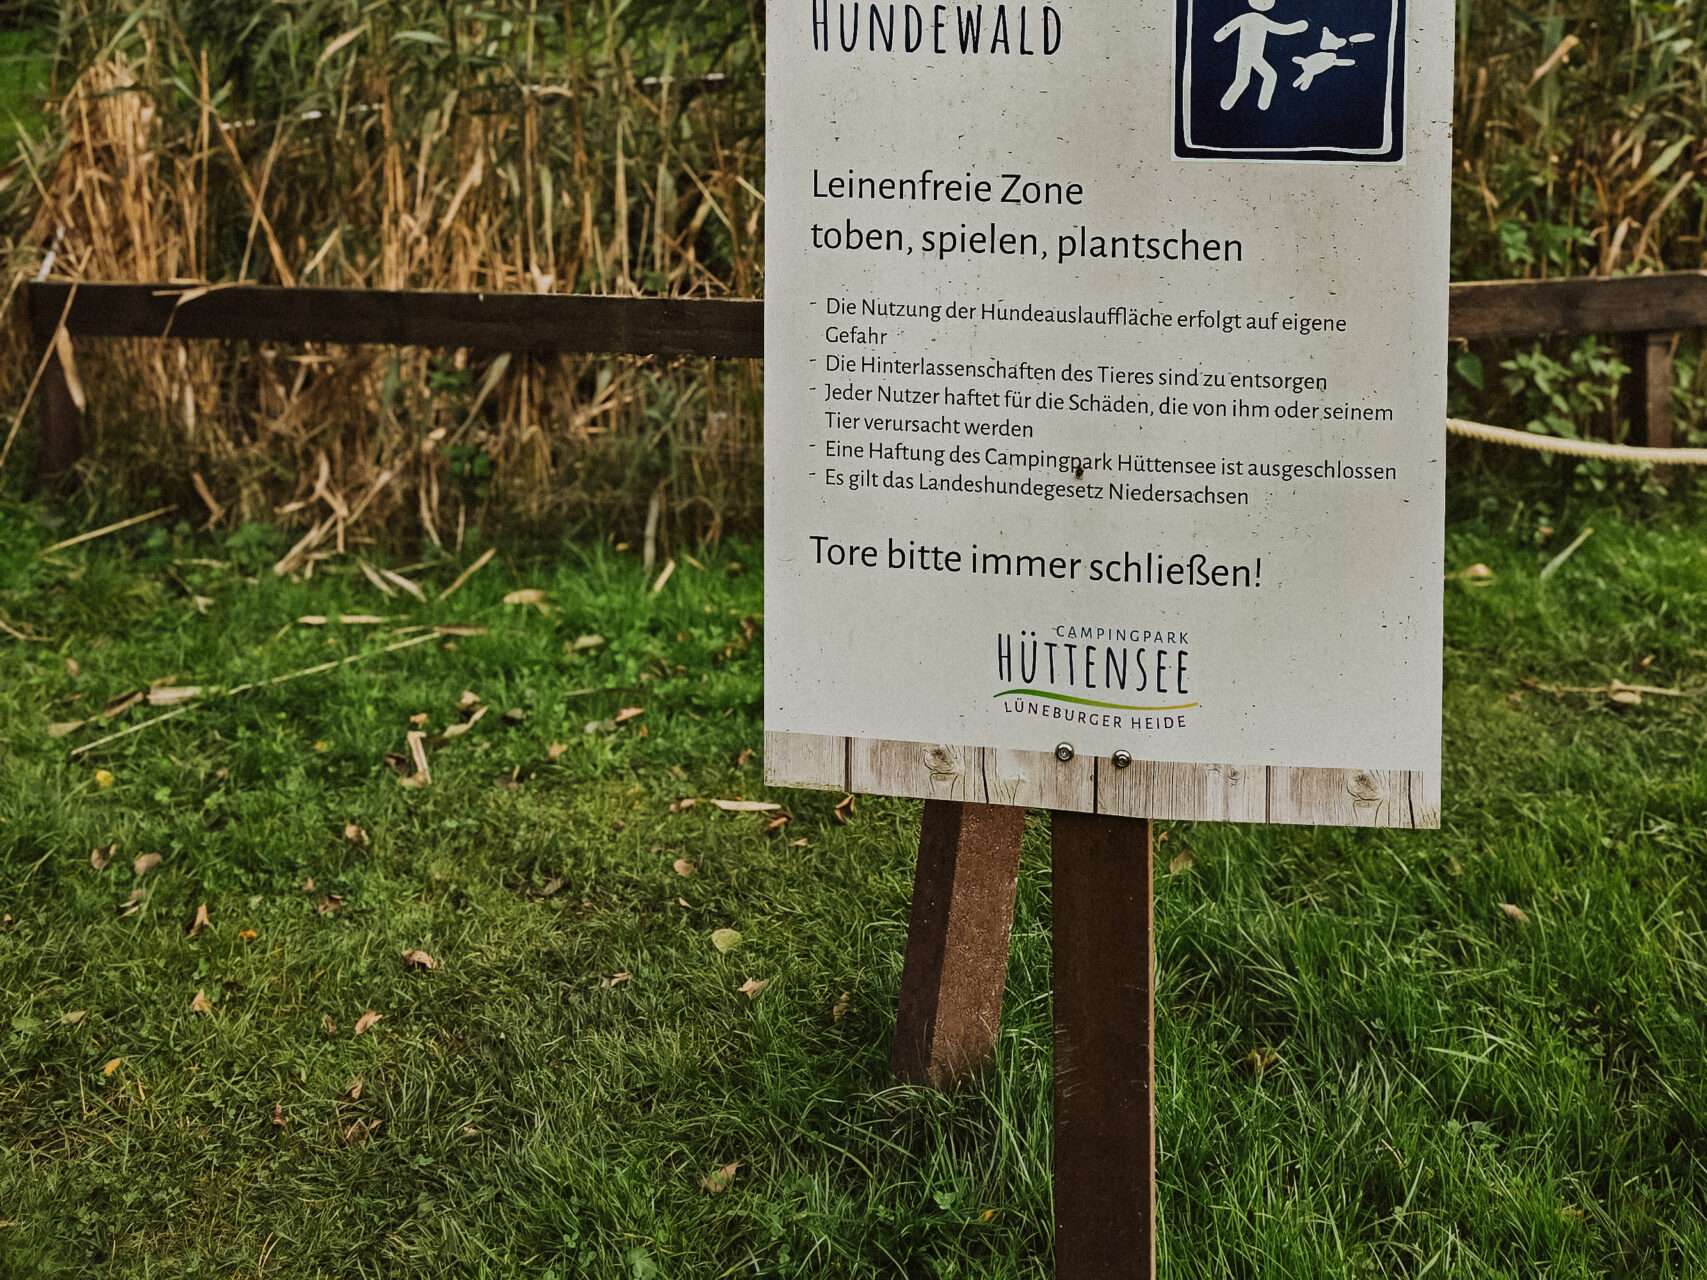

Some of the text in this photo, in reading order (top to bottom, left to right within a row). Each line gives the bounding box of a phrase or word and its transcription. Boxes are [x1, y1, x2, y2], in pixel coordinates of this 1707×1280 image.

[811, 168, 1085, 205] Leinenfreie Zone
[810, 221, 1244, 263] toben, spielen, plantschen
[824, 325, 888, 346] Gefahr
[825, 297, 1347, 336] Die Nutzung der Hundeauslauffläche erfolgt auf eigene
[825, 354, 1328, 394] Die Hinterlassenschaften des Tieres sind zu entsorgen
[823, 382, 1394, 422] Jeder Nutzer haftet für die Schäden, die von ihm oder seinem
[824, 412, 1034, 439] Tier verursacht werden
[824, 440, 1397, 482] Eine Haftung des Campingpark Hüttensee ist ausgeschlossen
[824, 469, 1250, 507] Es gilt das Landeshundegesetz Niedersachsen
[809, 535, 1263, 589] Tore bitte immer schließen!
[1055, 624, 1190, 645] CAMPINGPARK
[997, 629, 1190, 695] HÜTTENSEE
[1003, 697, 1187, 730] LÜNEBURGER HEIDE
